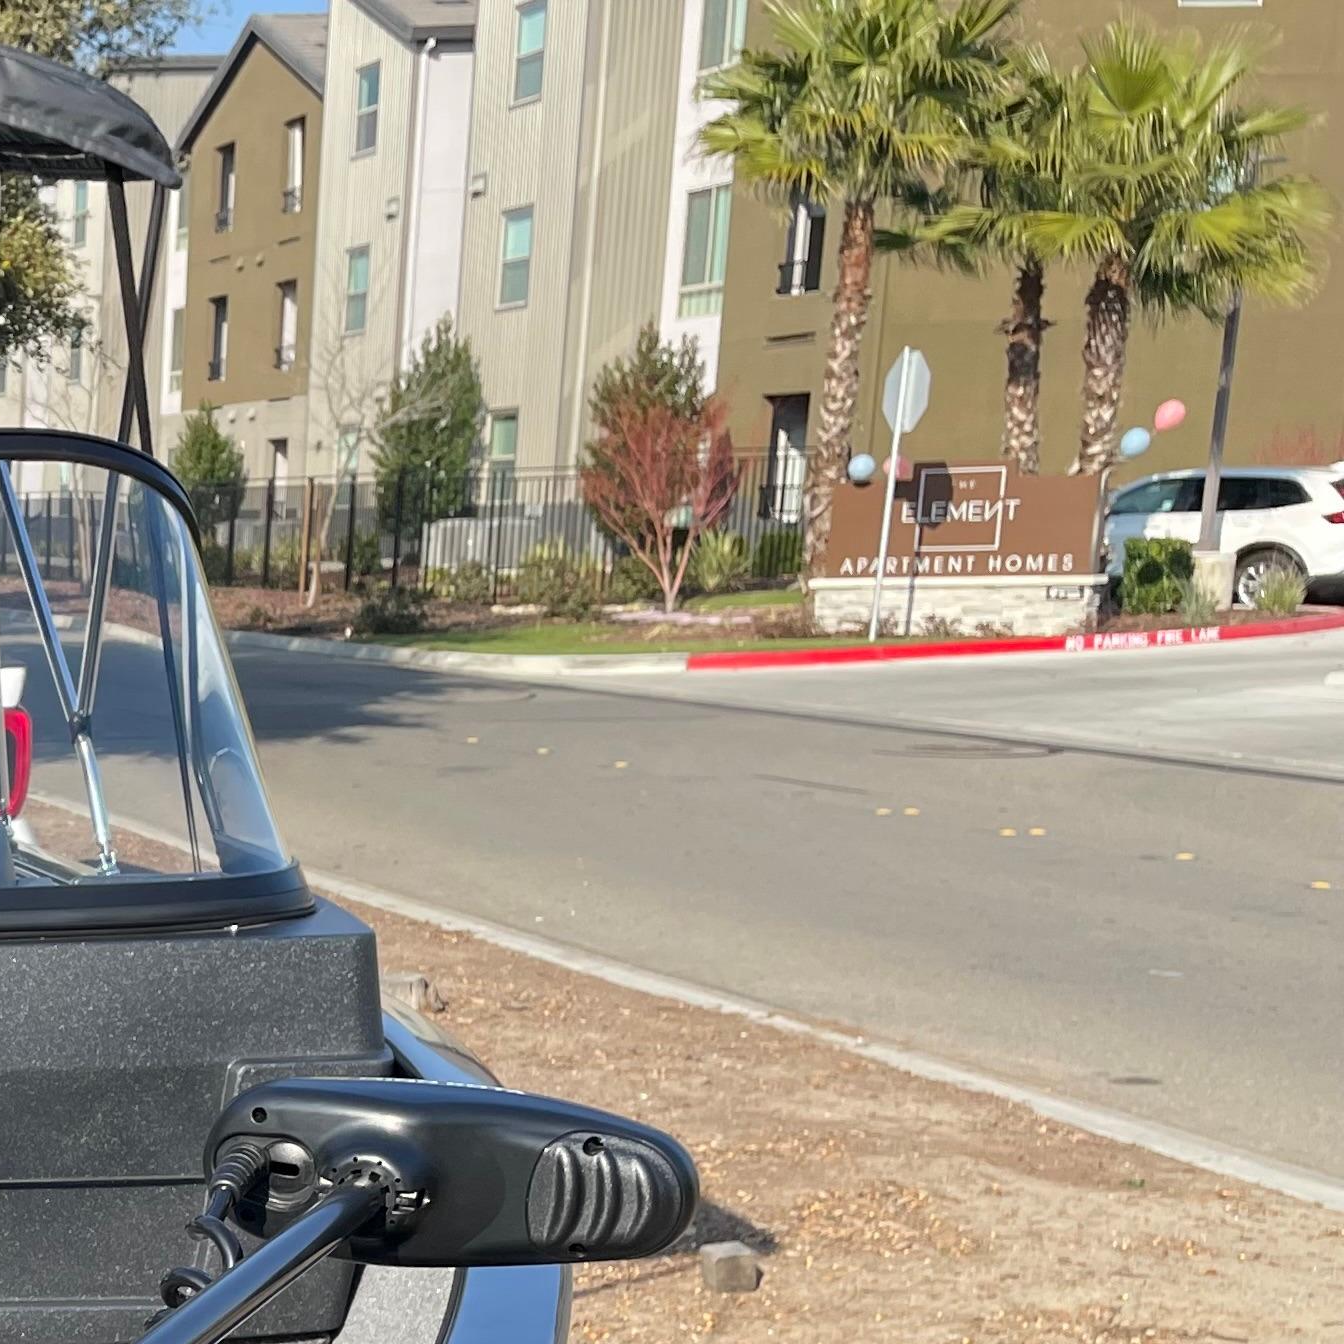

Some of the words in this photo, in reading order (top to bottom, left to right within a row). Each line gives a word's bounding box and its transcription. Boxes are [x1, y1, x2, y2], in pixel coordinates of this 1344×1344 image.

[901, 498, 1021, 524] ELEMENT
[840, 554, 976, 576] APARTMENT
[988, 553, 1073, 573] HOMES
[1065, 635, 1085, 652] NO
[1093, 632, 1148, 650] PARKING
[1157, 629, 1183, 646] FIRE
[1191, 626, 1220, 642] LANE
